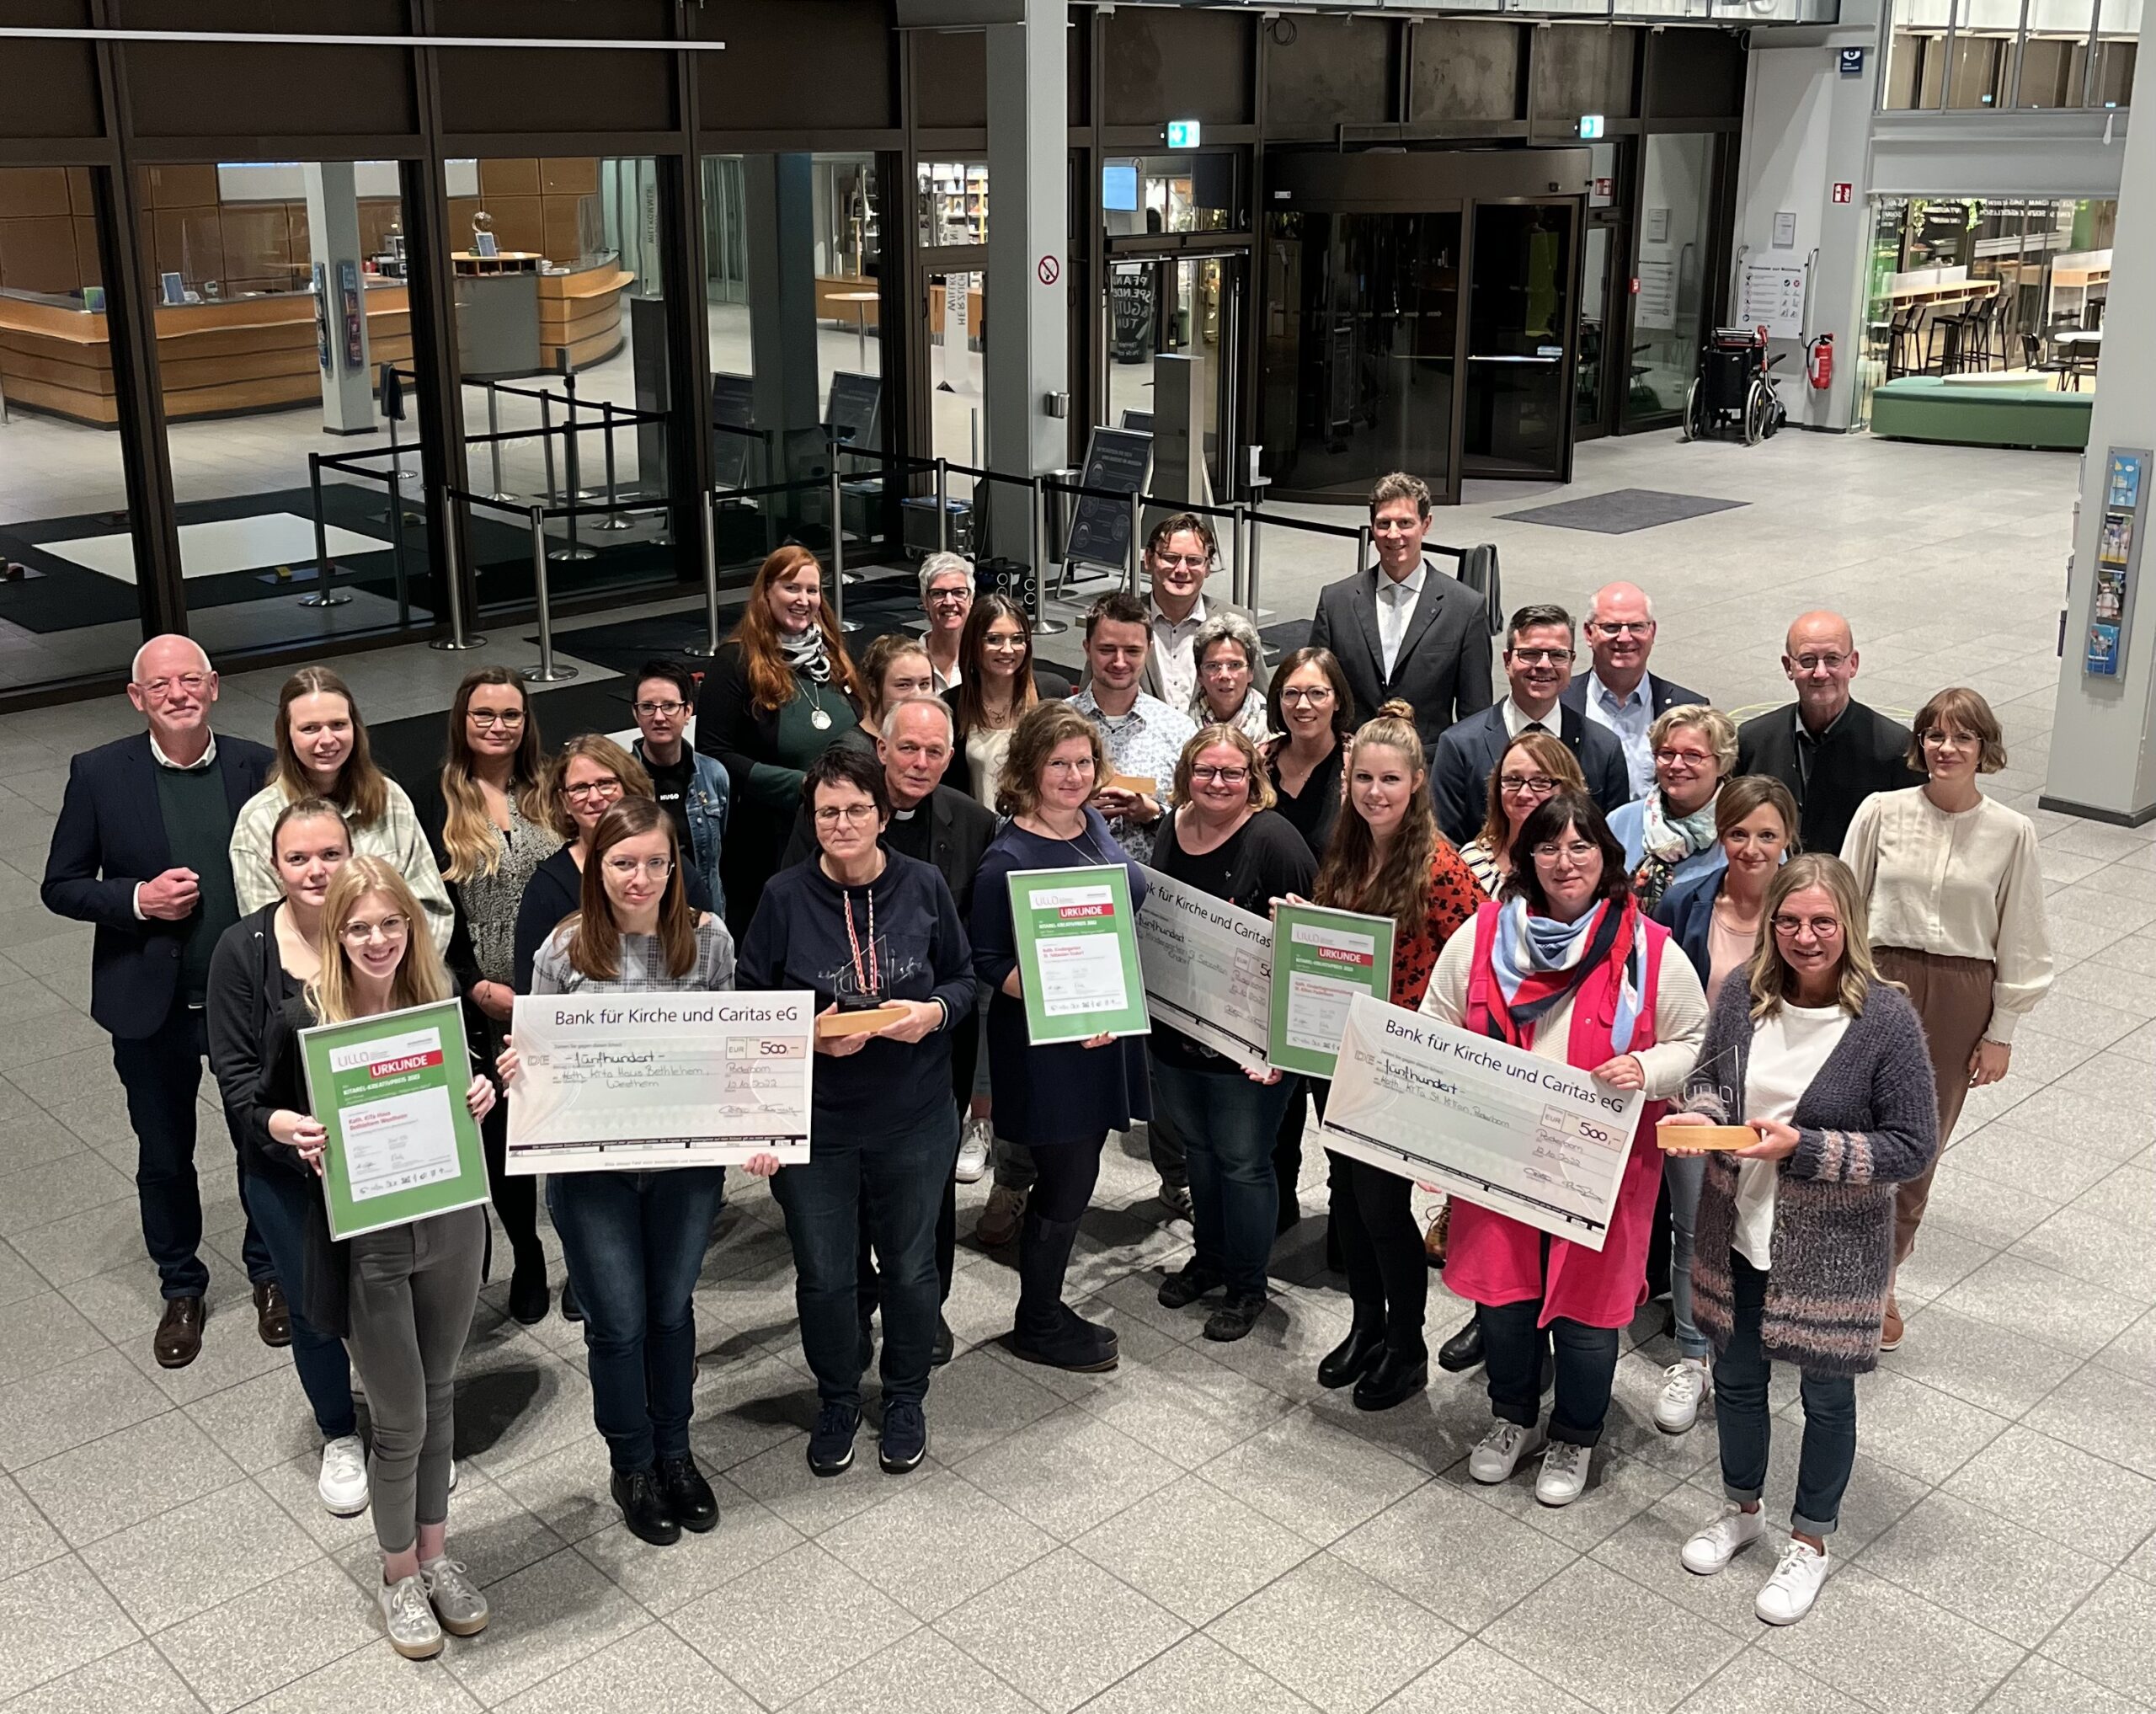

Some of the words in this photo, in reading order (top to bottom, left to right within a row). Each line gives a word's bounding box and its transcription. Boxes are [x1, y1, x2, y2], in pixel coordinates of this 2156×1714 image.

[659, 793, 680, 801] HUGO
[1060, 906, 1103, 917] URKUNDE
[1159, 886, 1175, 903] für
[1176, 894, 1208, 919] Kirche
[1210, 912, 1232, 930] und
[1235, 922, 1272, 948] Caritas
[1319, 948, 1362, 963] URKUNDE
[555, 1009, 595, 1025] Bank
[600, 1009, 624, 1023] für
[629, 1008, 677, 1023] Kirche
[683, 1007, 713, 1022] und
[719, 1007, 771, 1022] Caritas
[776, 1007, 798, 1021] eG
[527, 1055, 550, 1066] DE
[1354, 1049, 1375, 1065] DE
[371, 1055, 428, 1076] URKUNDE
[1385, 1019, 1424, 1044] Bank
[1428, 1034, 1450, 1052] für
[1454, 1043, 1502, 1071] Kirche
[1506, 1064, 1539, 1083] und
[1542, 1075, 1597, 1103] Caritas
[1601, 1097, 1625, 1113] eG
[1545, 1114, 1561, 1124] EUR
